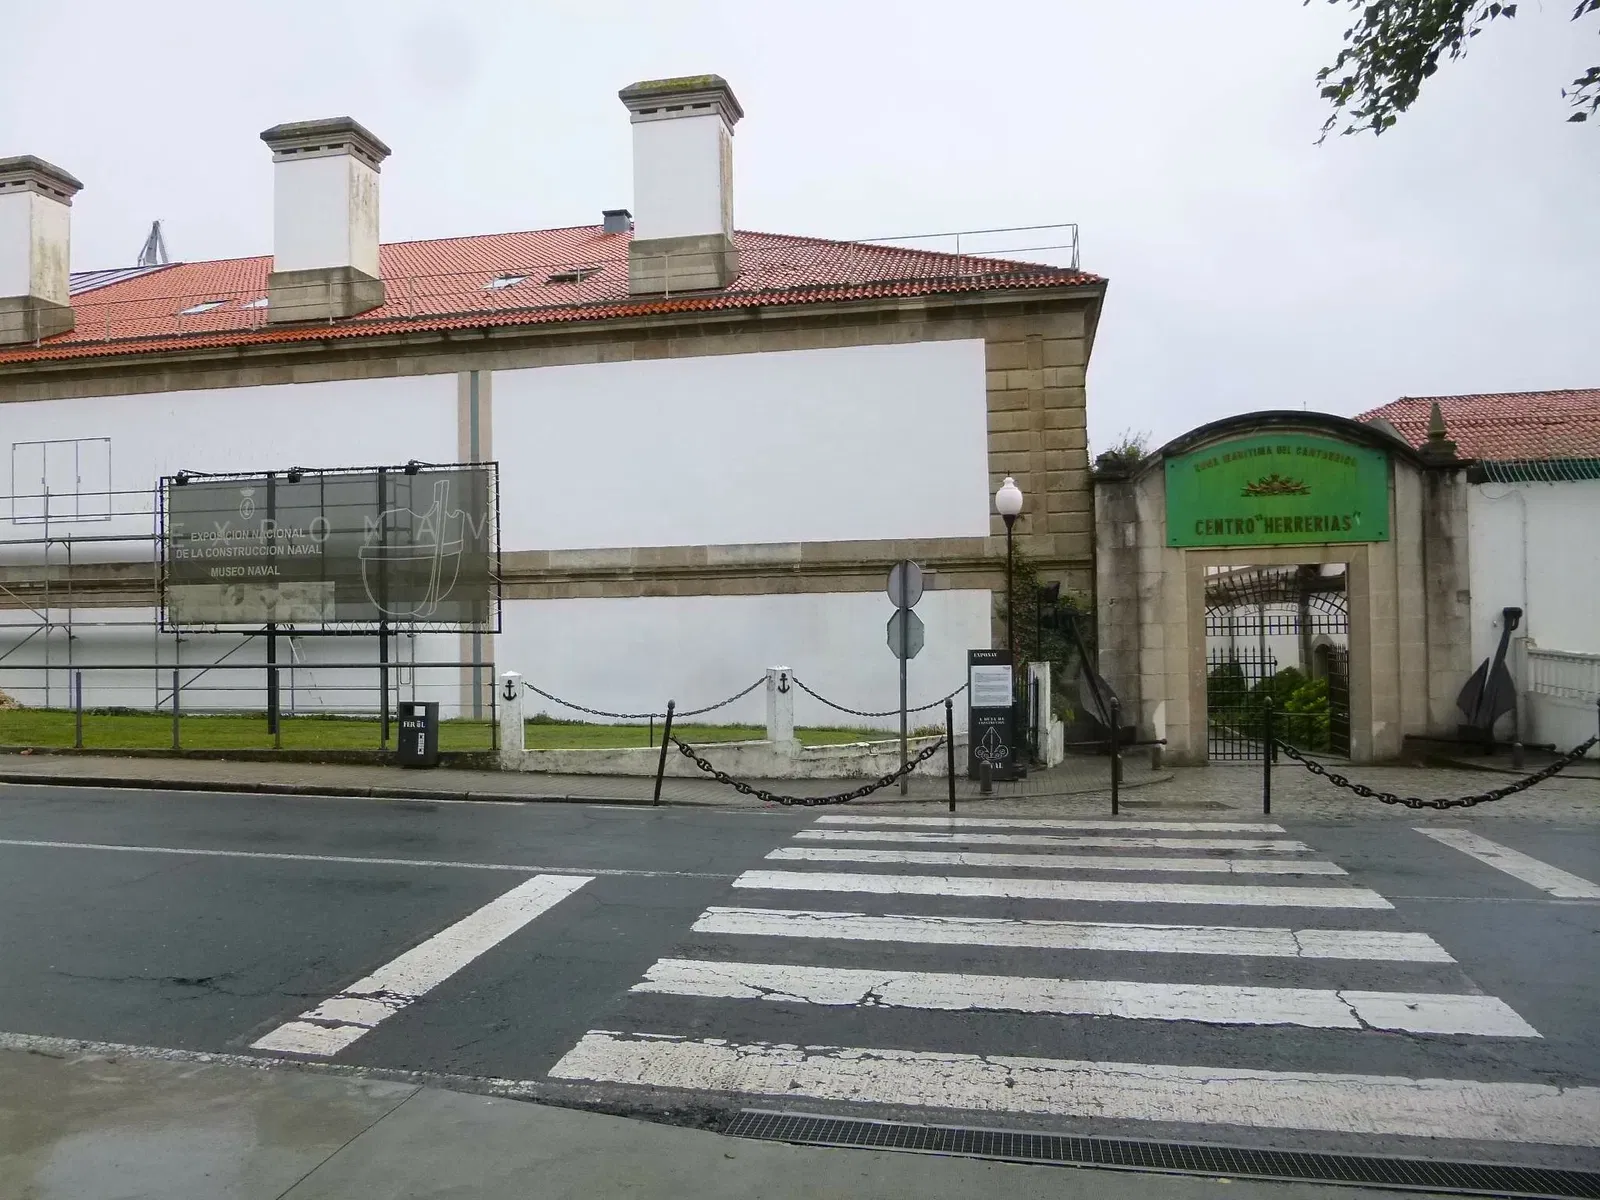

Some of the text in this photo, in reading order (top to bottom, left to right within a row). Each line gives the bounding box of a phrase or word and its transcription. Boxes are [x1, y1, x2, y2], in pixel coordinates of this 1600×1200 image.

[1276, 445, 1291, 455] DEL
[1195, 517, 1255, 536] CENTRO
[253, 527, 306, 540] NACIONAL
[175, 544, 322, 559] DE LA CONSTRUCCION NAVAL
[210, 565, 280, 577] MUSEO NAVAL
